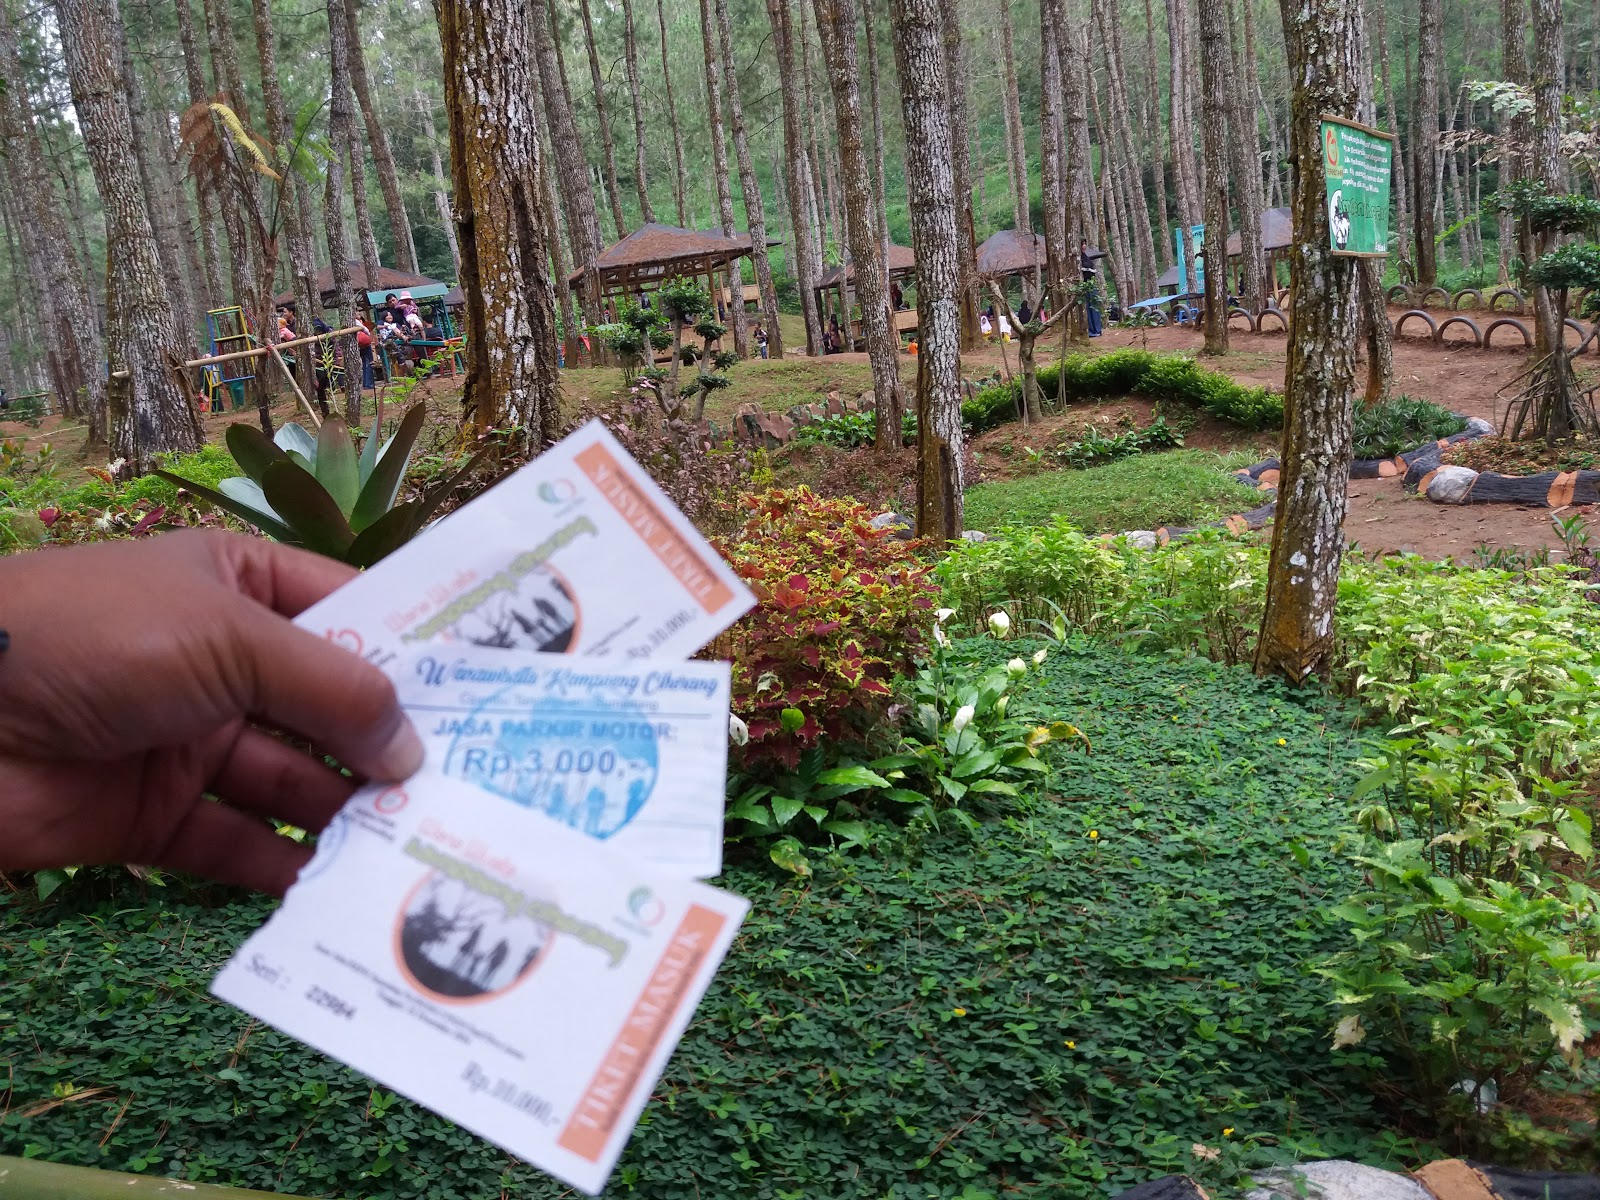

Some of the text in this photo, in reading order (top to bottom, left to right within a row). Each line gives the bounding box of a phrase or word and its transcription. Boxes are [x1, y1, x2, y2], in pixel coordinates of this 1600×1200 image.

[594, 463, 656, 540] MASUK
[656, 538, 713, 599] TIKET
[433, 718, 493, 737] JASA
[576, 1038, 638, 1130] TIKET
[630, 931, 703, 1031] MASUK
